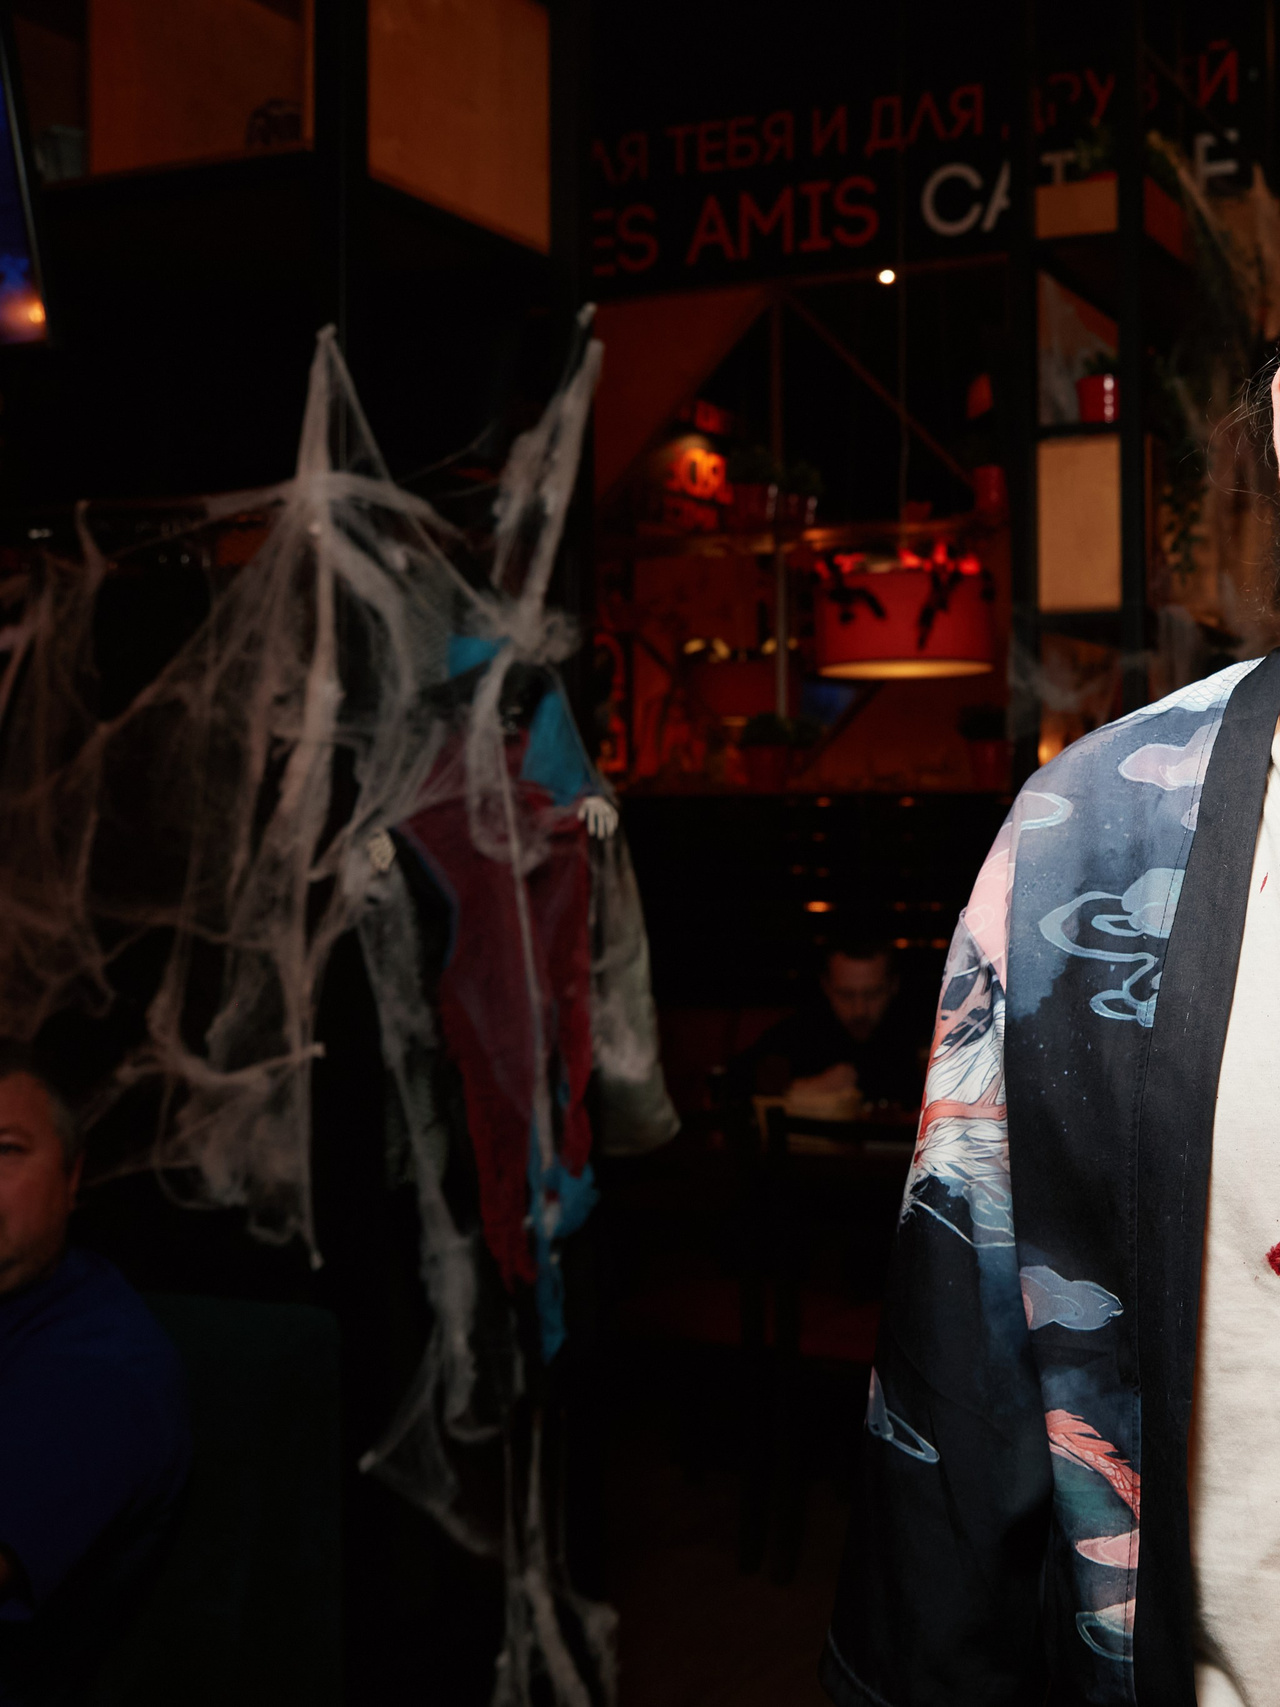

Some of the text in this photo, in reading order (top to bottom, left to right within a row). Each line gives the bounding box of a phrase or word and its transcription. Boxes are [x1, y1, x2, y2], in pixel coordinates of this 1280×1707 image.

[663, 107, 795, 177] ТЕБЯ
[810, 103, 849, 157] И
[863, 82, 985, 160] ДЛЯ
[684, 174, 880, 267] AMIS
